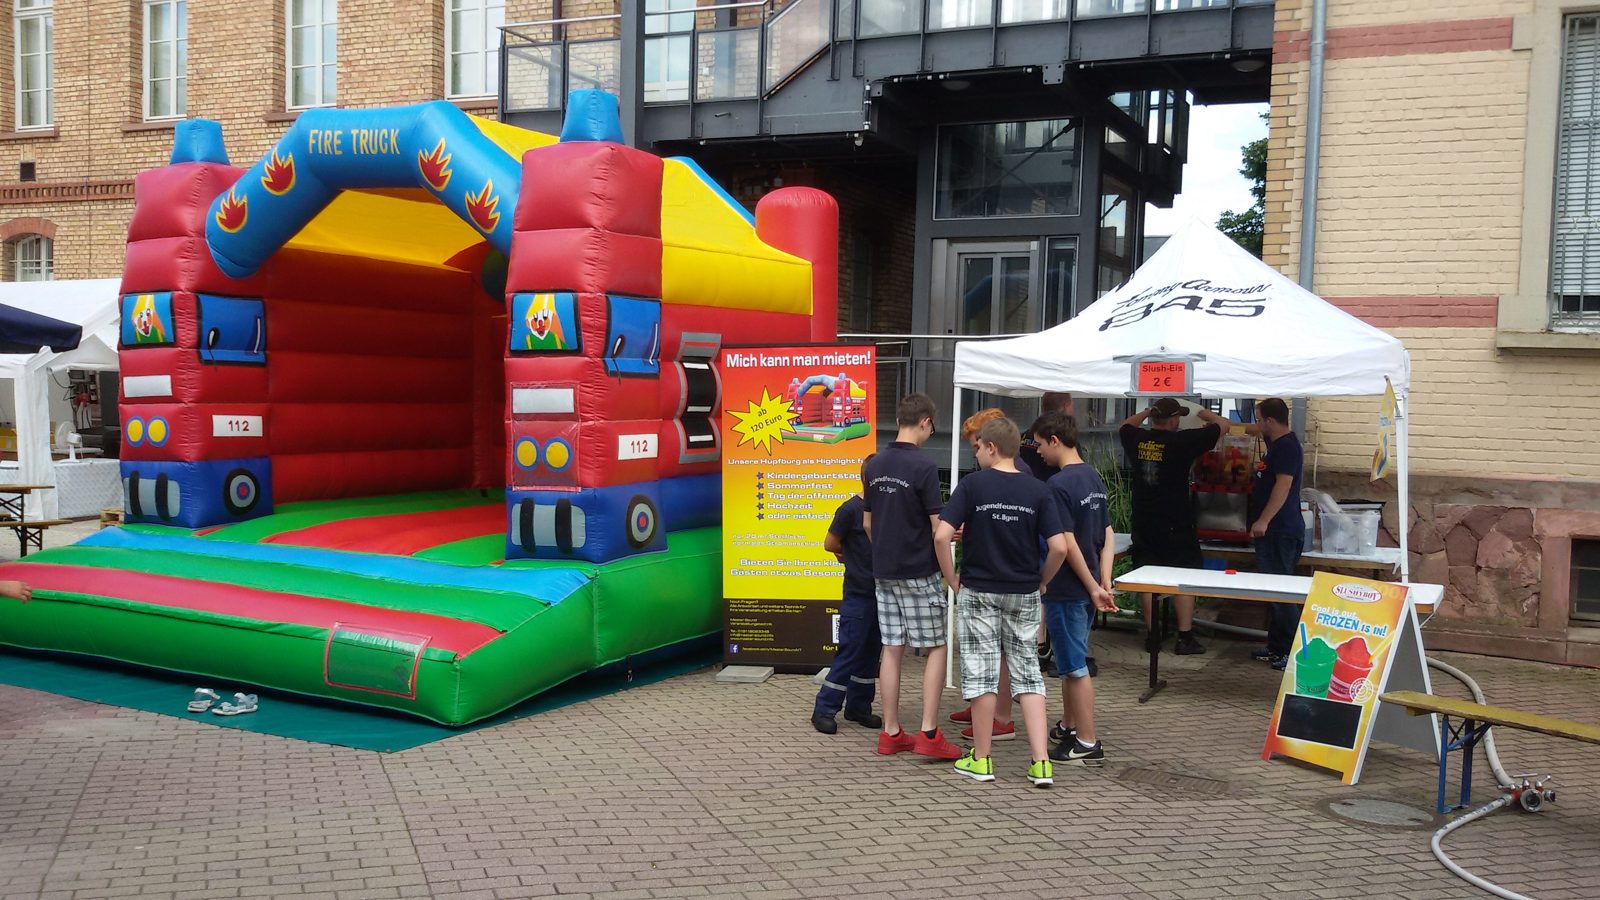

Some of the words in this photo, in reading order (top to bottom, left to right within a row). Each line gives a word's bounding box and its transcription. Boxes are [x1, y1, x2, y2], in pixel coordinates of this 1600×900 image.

[308, 128, 343, 155] FIRE
[351, 128, 400, 155] TRUCK
[1098, 295, 1266, 332] 845
[726, 353, 758, 368] Mich
[760, 353, 790, 367] kann
[792, 355, 820, 366] man
[822, 351, 871, 366] mieten!
[1142, 364, 1183, 372] Slush-Eis
[1153, 377, 1160, 387] 2
[1164, 376, 1172, 387] €
[758, 408, 768, 417] ab
[228, 420, 250, 432] 112
[750, 422, 764, 432] 120
[764, 414, 782, 426] Euro
[630, 440, 648, 454] 112
[768, 492, 786, 500] Tag
[1311, 604, 1330, 613] Cool
[1315, 612, 1360, 631] FROZEN
[1361, 624, 1371, 634] IS
[1373, 625, 1388, 637] IN!
